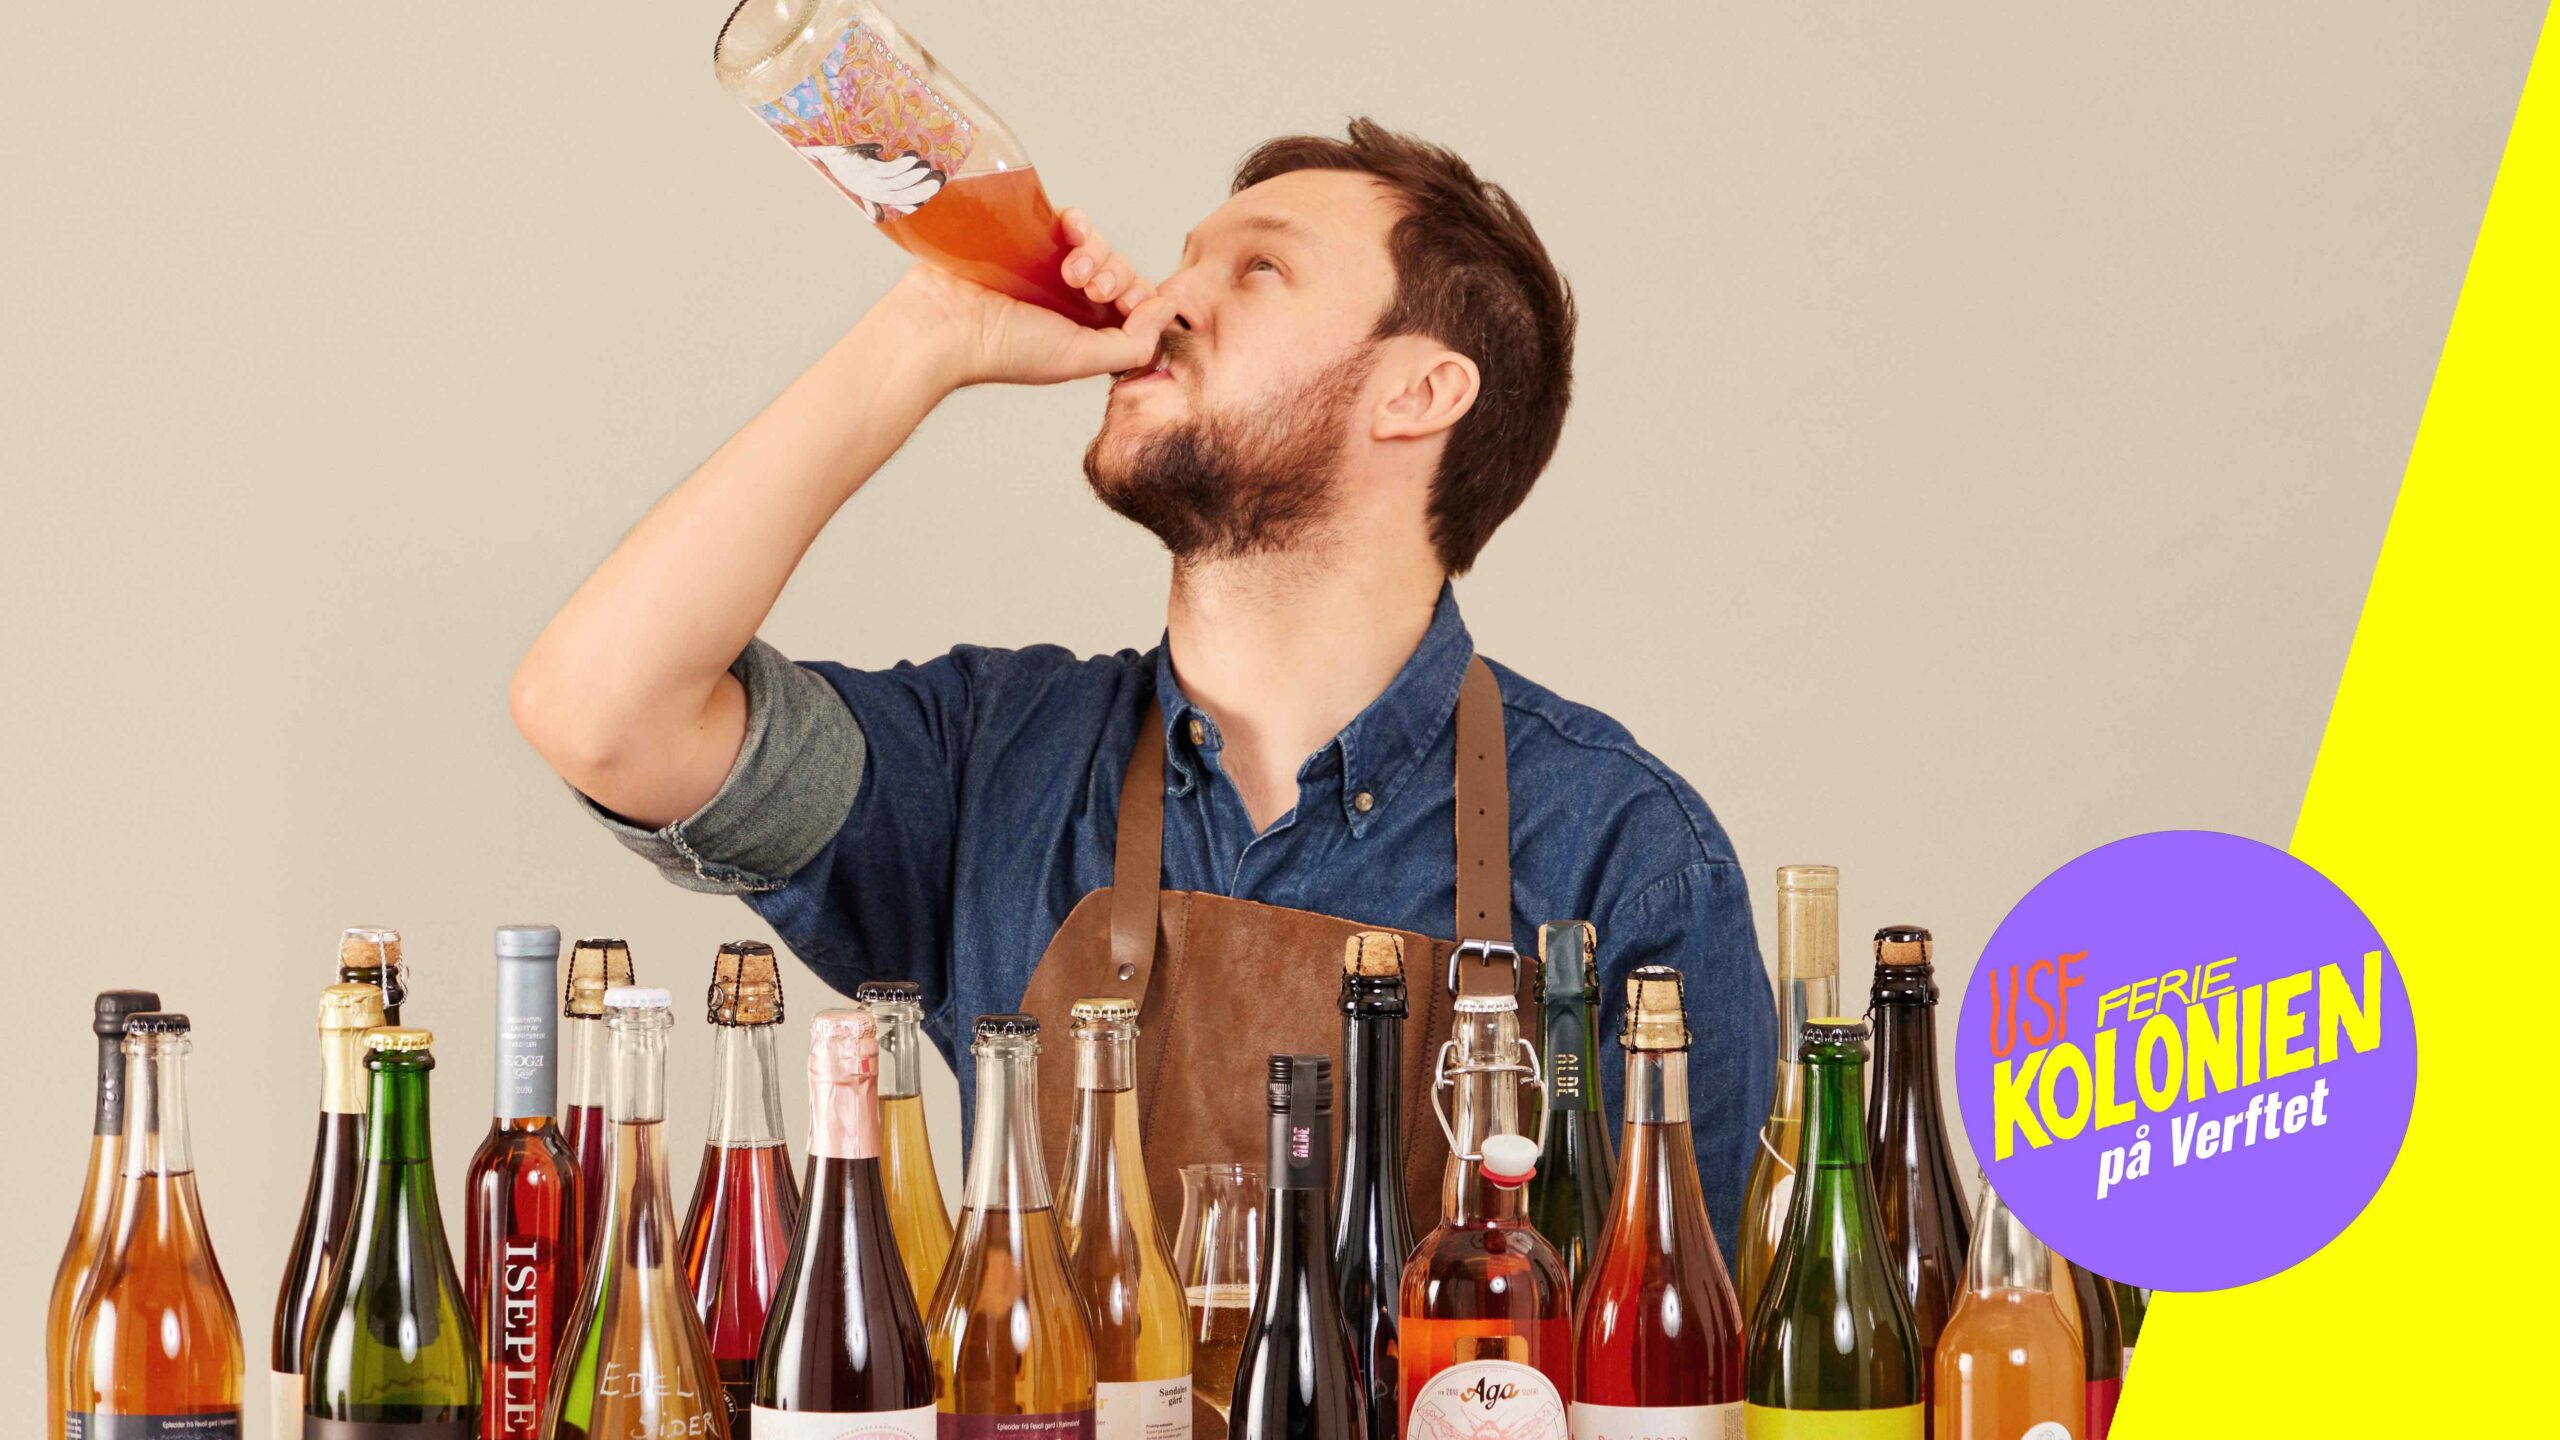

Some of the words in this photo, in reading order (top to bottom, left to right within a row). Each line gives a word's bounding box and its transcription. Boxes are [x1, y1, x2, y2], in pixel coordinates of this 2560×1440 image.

[1555, 1053, 1579, 1098] ALDE
[1292, 1127, 1310, 1158] ALDE
[504, 1242, 538, 1433] ISEPLE
[600, 1362, 694, 1398] EDEL
[1460, 1376, 1519, 1410] Aga
[997, 1422, 1020, 1432] Eplecider
